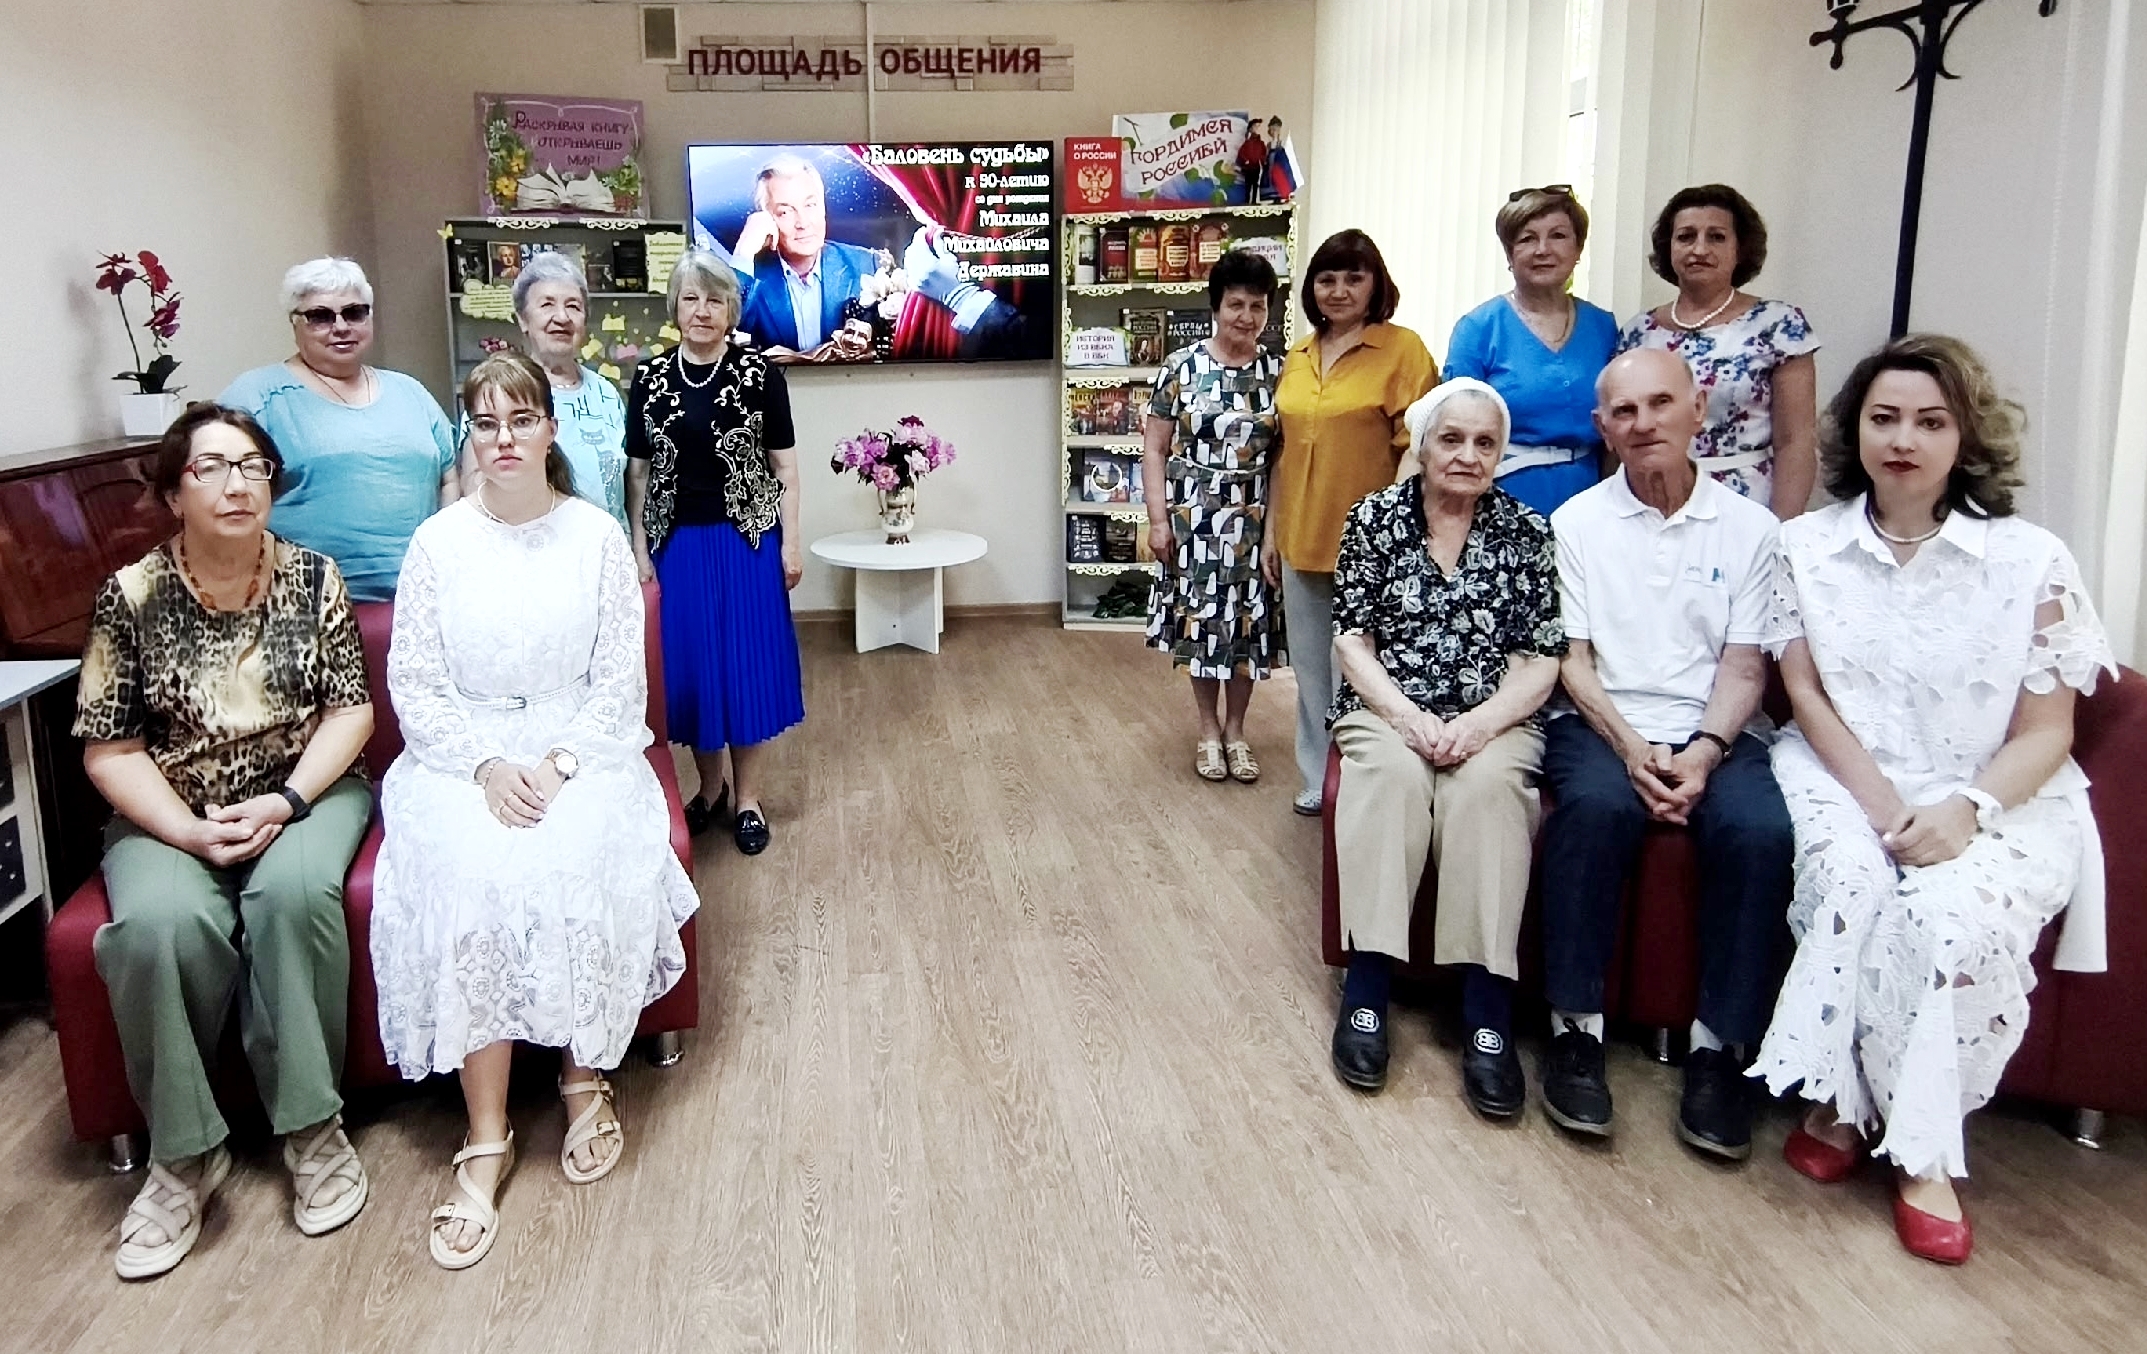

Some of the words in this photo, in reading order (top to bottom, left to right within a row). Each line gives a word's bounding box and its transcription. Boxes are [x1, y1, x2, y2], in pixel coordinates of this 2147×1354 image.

[687, 48, 862, 81] ПЛОЩАДЬ
[879, 47, 1042, 79] ОБЩЕНИЯ
[537, 136, 622, 150] ОТКРЫВАЕШЬ
[1073, 142, 1101, 151] КНИГА
[1130, 118, 1233, 165] ГОРДИМСЯ
[969, 143, 1050, 167] судьбы»
[1073, 152, 1081, 160] О
[1081, 151, 1117, 160] РОССИИ
[1141, 137, 1228, 185] РОССИЕЙ
[979, 210, 1050, 227] Михаила
[943, 235, 1050, 254] Михайловича
[957, 261, 1050, 282] Державина
